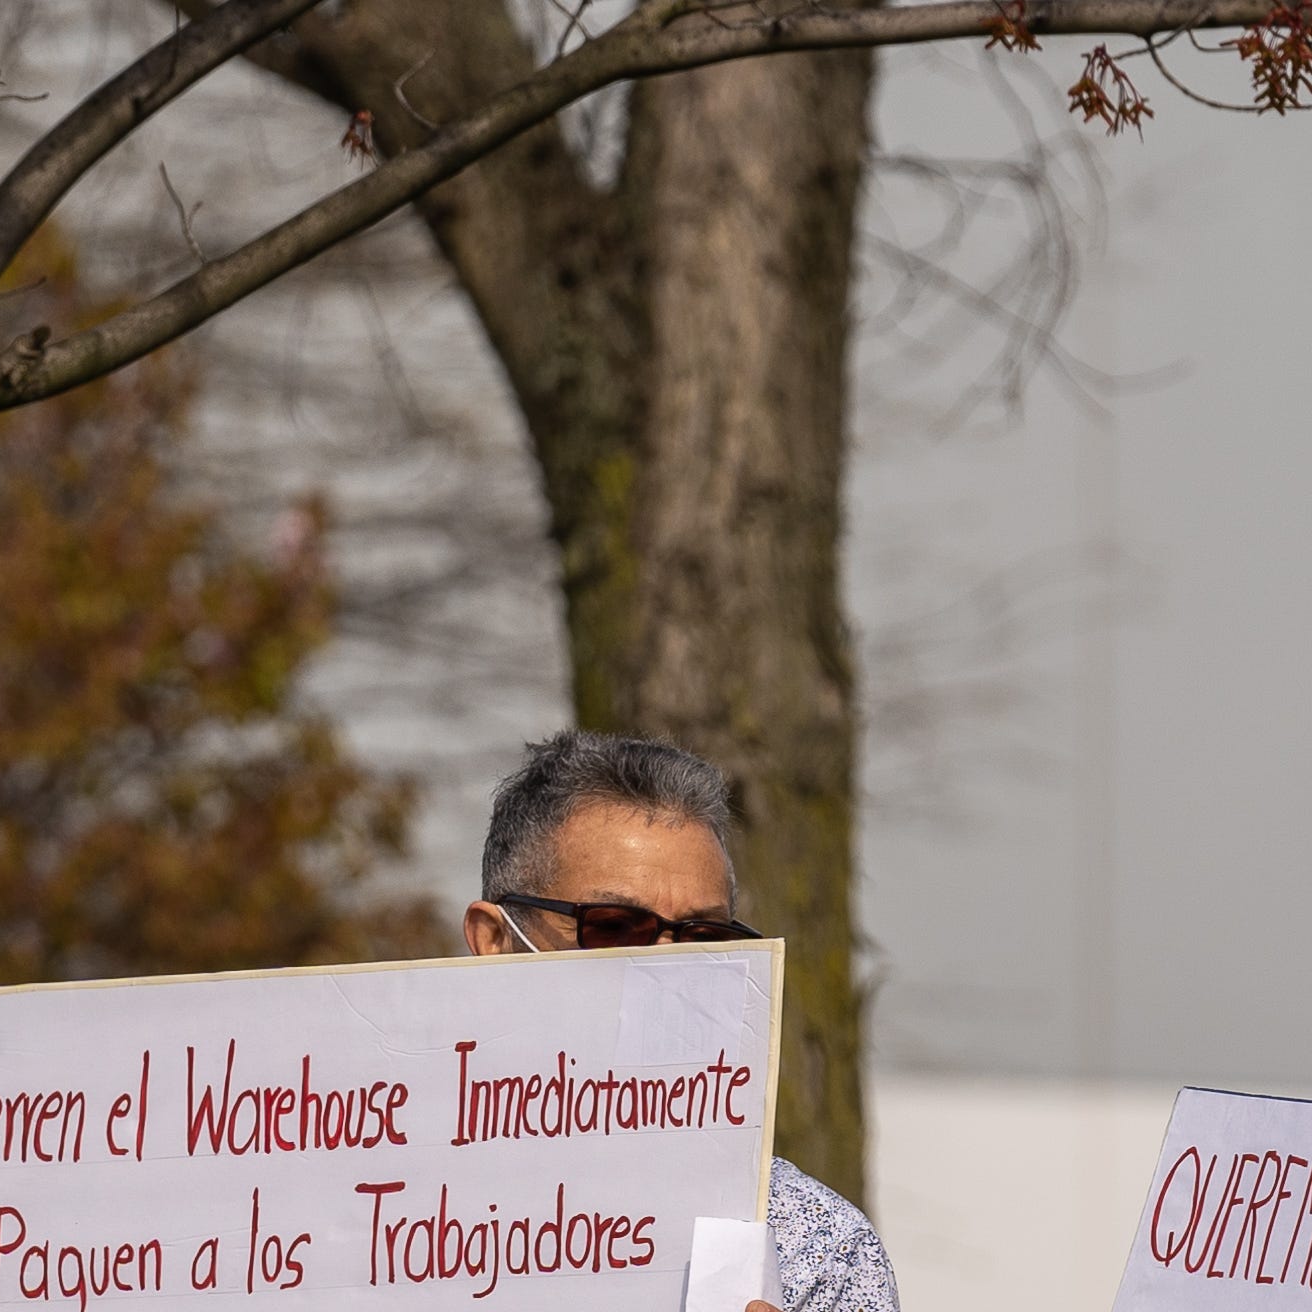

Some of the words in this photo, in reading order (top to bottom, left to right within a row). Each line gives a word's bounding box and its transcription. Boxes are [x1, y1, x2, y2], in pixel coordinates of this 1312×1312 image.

[106, 1050, 150, 1162] el
[187, 1038, 408, 1156] Warehouse
[191, 1237, 218, 1290] a
[247, 1187, 311, 1294] los
[354, 1181, 655, 1298] Trabajadores
